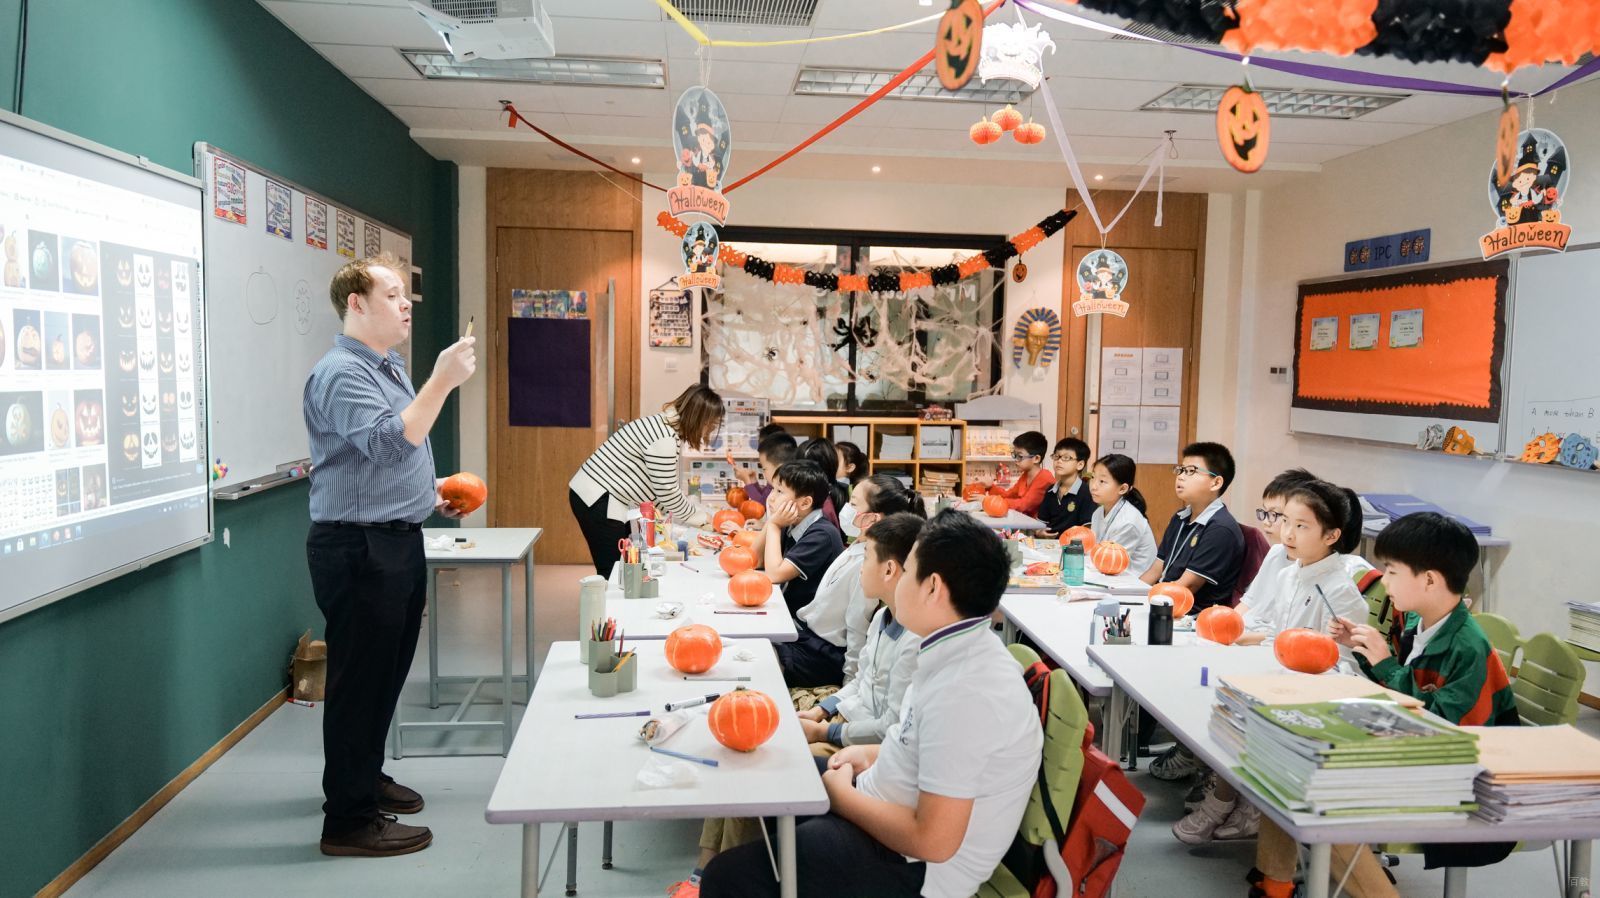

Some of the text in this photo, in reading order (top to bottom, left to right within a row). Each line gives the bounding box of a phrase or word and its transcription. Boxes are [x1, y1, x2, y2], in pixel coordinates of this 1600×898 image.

[671, 188, 725, 221] Halloween
[1484, 225, 1566, 250] Halloween
[1375, 245, 1392, 261] IPC
[680, 275, 717, 287] Halloween
[1075, 302, 1126, 314] Halloween
[1531, 407, 1537, 416] A
[1588, 407, 1595, 418] B
